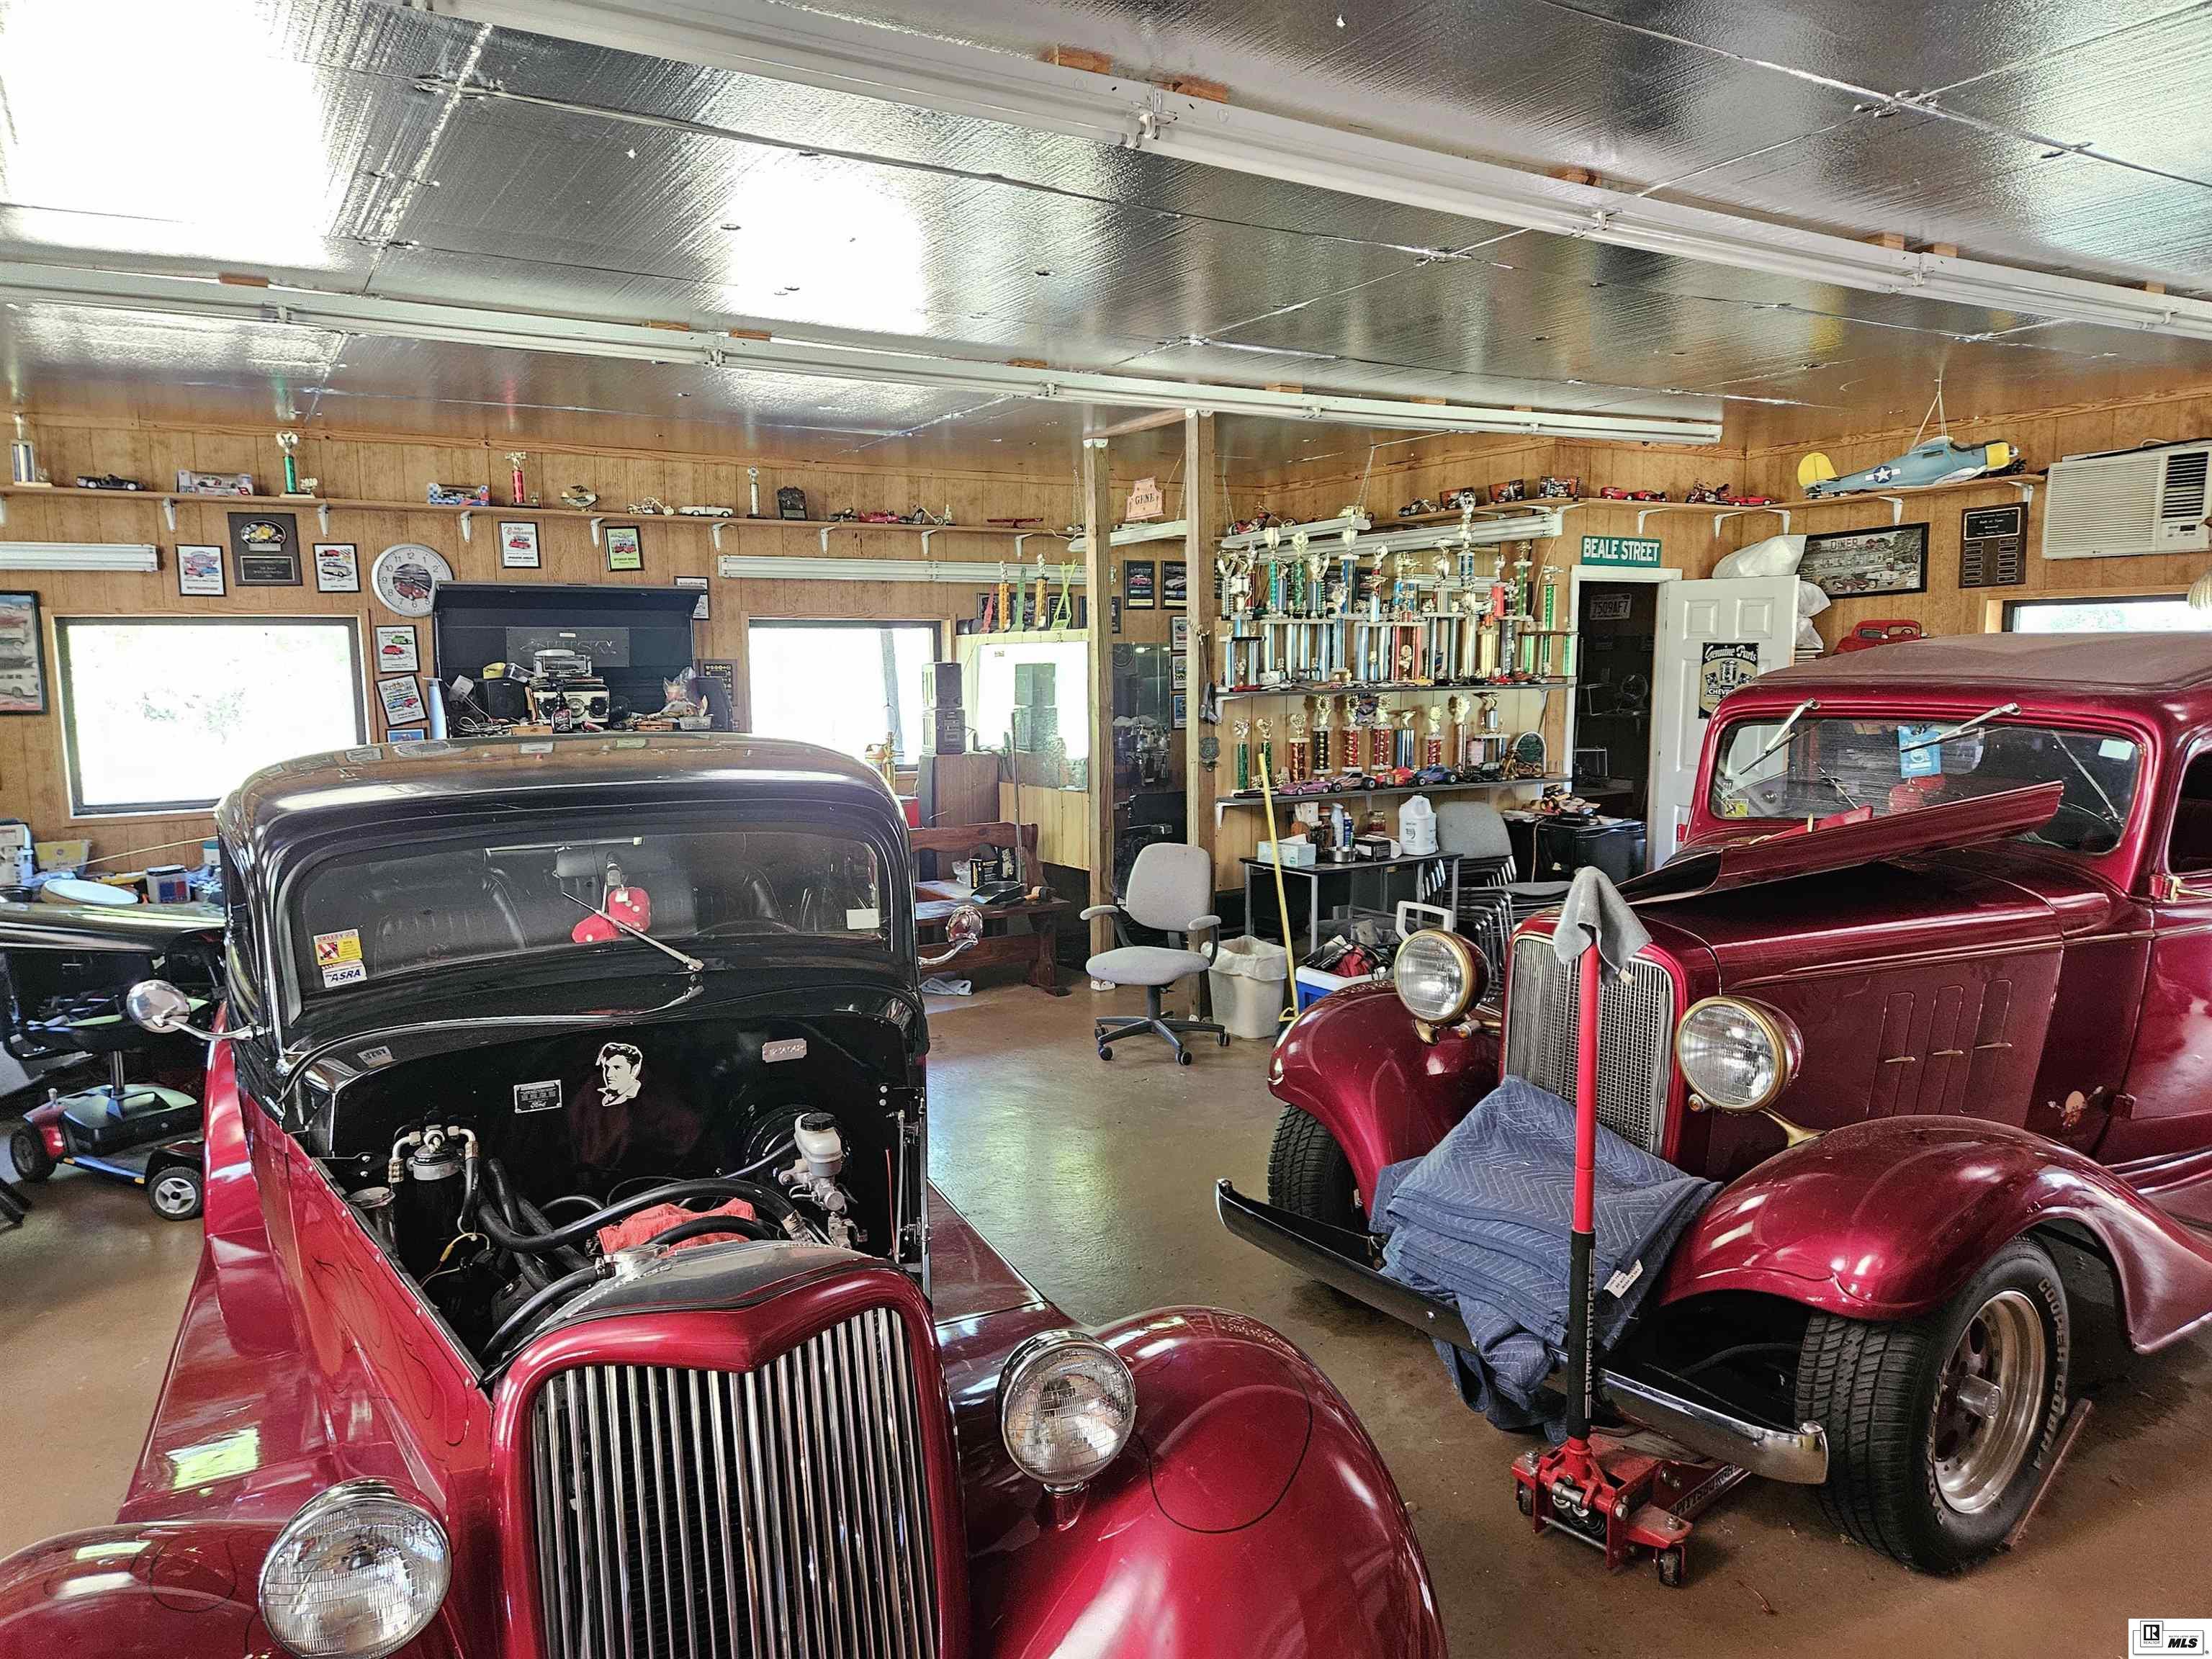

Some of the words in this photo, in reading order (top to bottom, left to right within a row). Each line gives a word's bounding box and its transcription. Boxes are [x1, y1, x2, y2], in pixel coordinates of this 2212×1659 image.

[1583, 537, 1619, 559] BEALE
[1620, 540, 1660, 562] STREET
[2038, 1277, 2065, 1362] COOPER
[2033, 1378, 2067, 1470] COBRA
